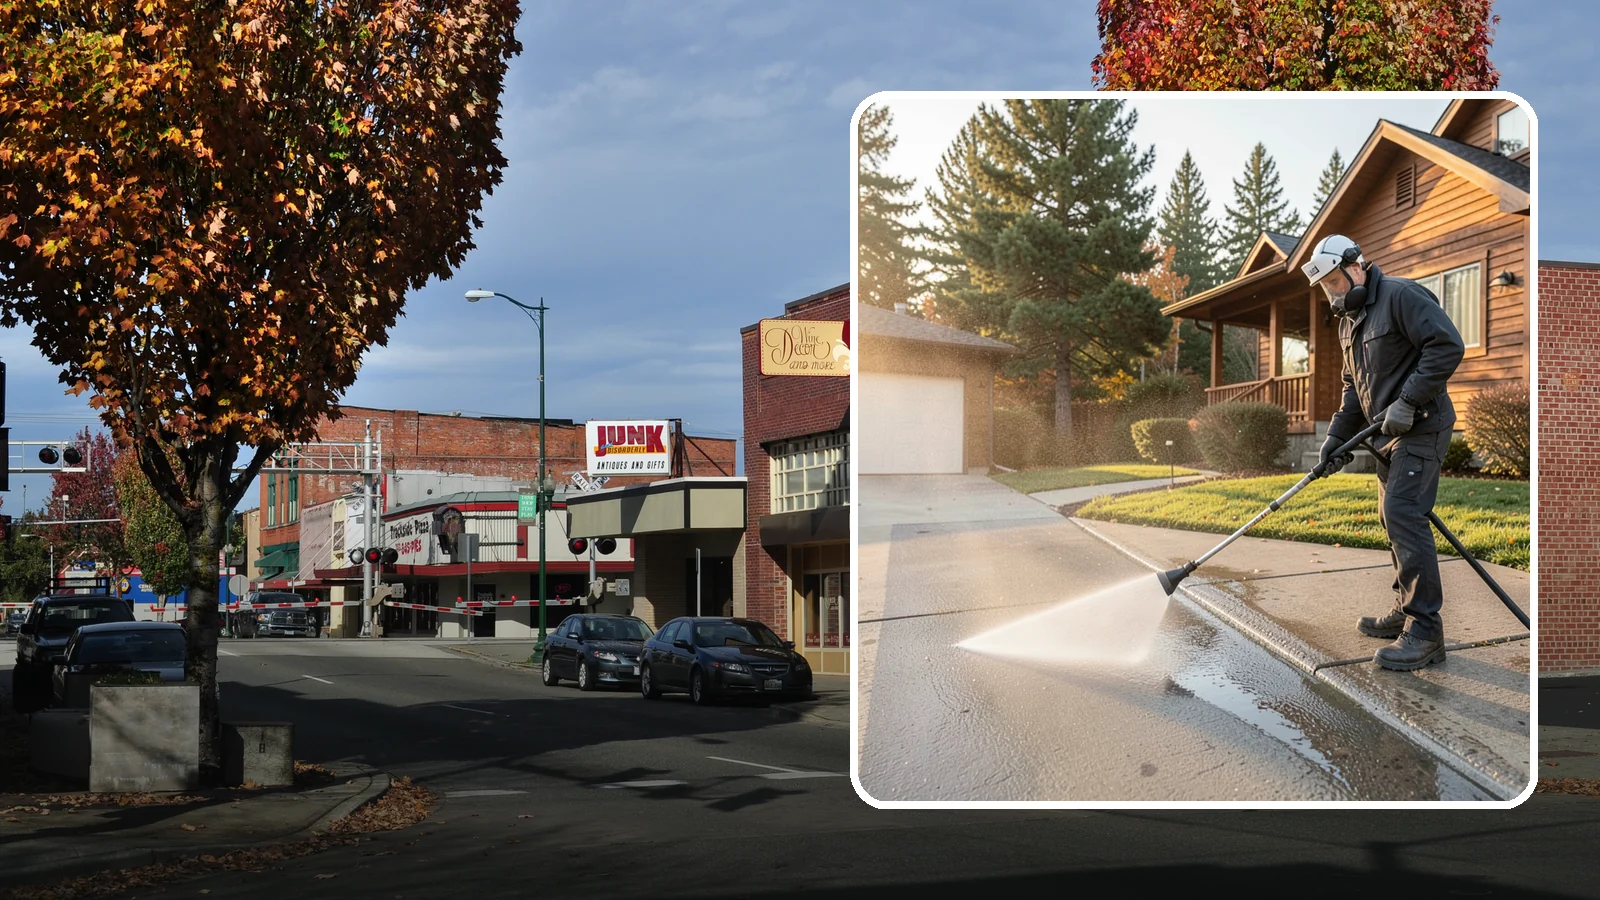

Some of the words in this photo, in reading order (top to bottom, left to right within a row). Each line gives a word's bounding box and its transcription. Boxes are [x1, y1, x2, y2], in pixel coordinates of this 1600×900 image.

[595, 425, 665, 457] JUNK
[608, 446, 646, 454] DISORDERLY
[597, 461, 628, 470] ANTIQUES
[631, 461, 644, 470] AND
[647, 460, 666, 469] GIFTS
[414, 519, 429, 535] Pizza
